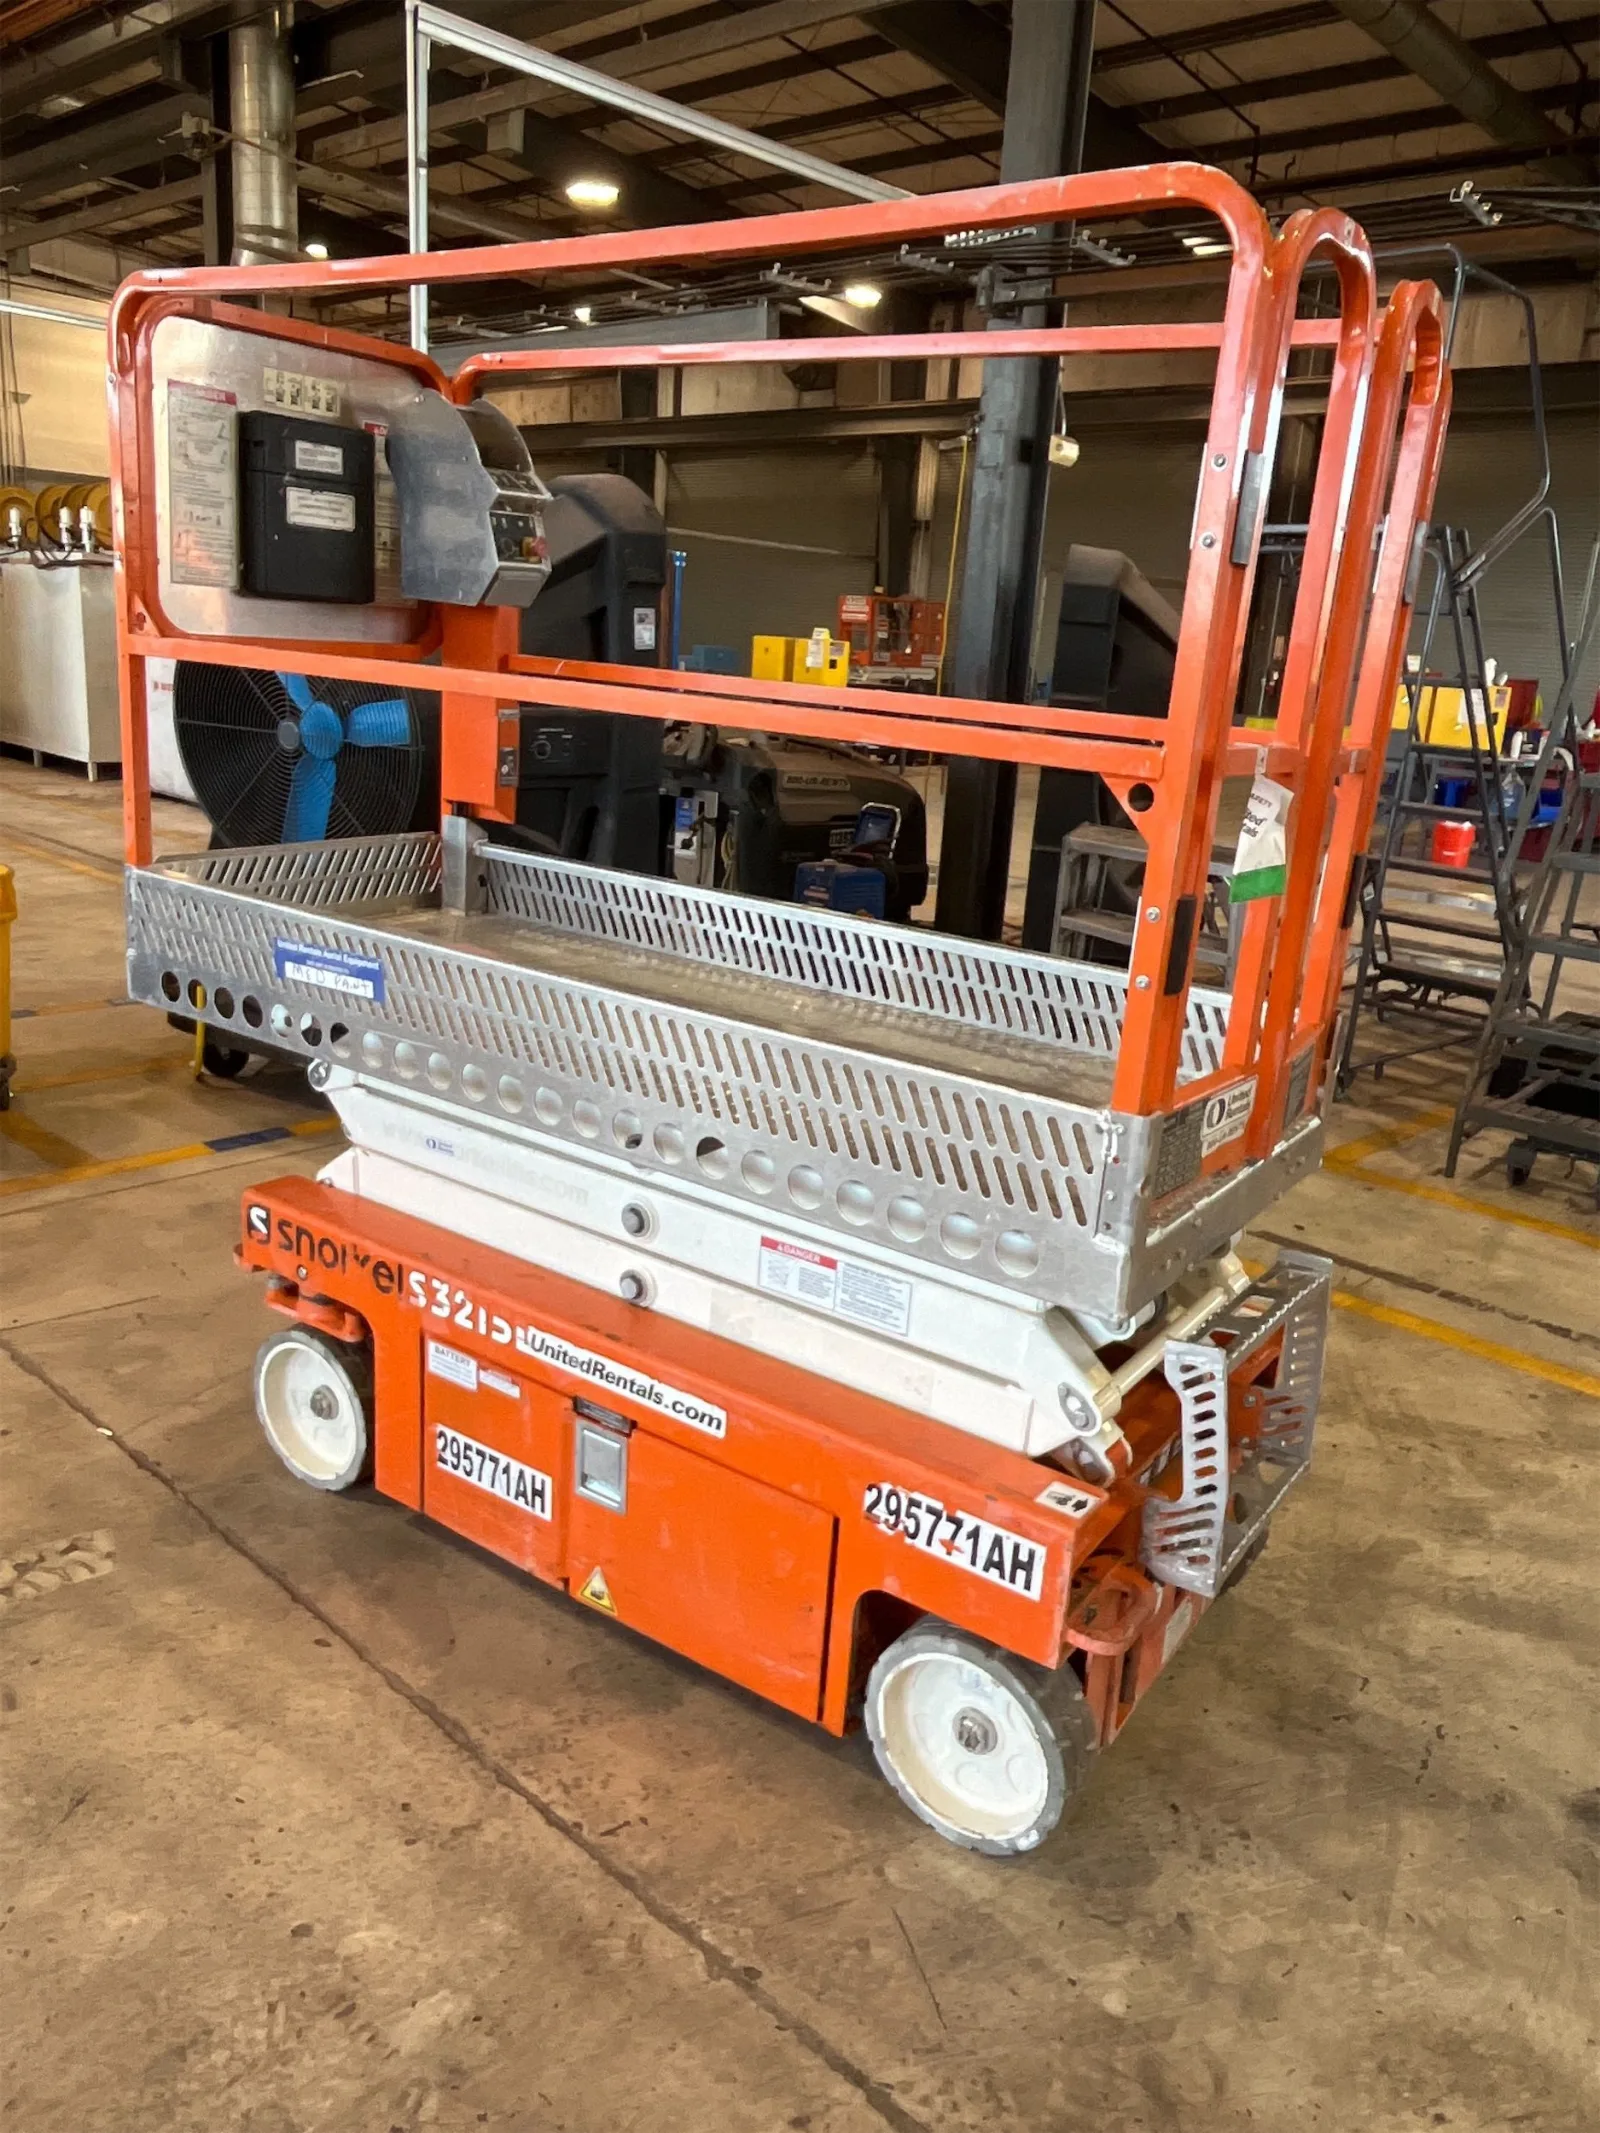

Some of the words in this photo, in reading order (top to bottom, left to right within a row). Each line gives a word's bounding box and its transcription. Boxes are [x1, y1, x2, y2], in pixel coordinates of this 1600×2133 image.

[784, 1245, 821, 1264] DANGER
[433, 1345, 471, 1368] BATTERY
[530, 1332, 722, 1431] UnitedRentals.com
[437, 1430, 546, 1514] 295771AH
[866, 1483, 1036, 1592] 295771AH
